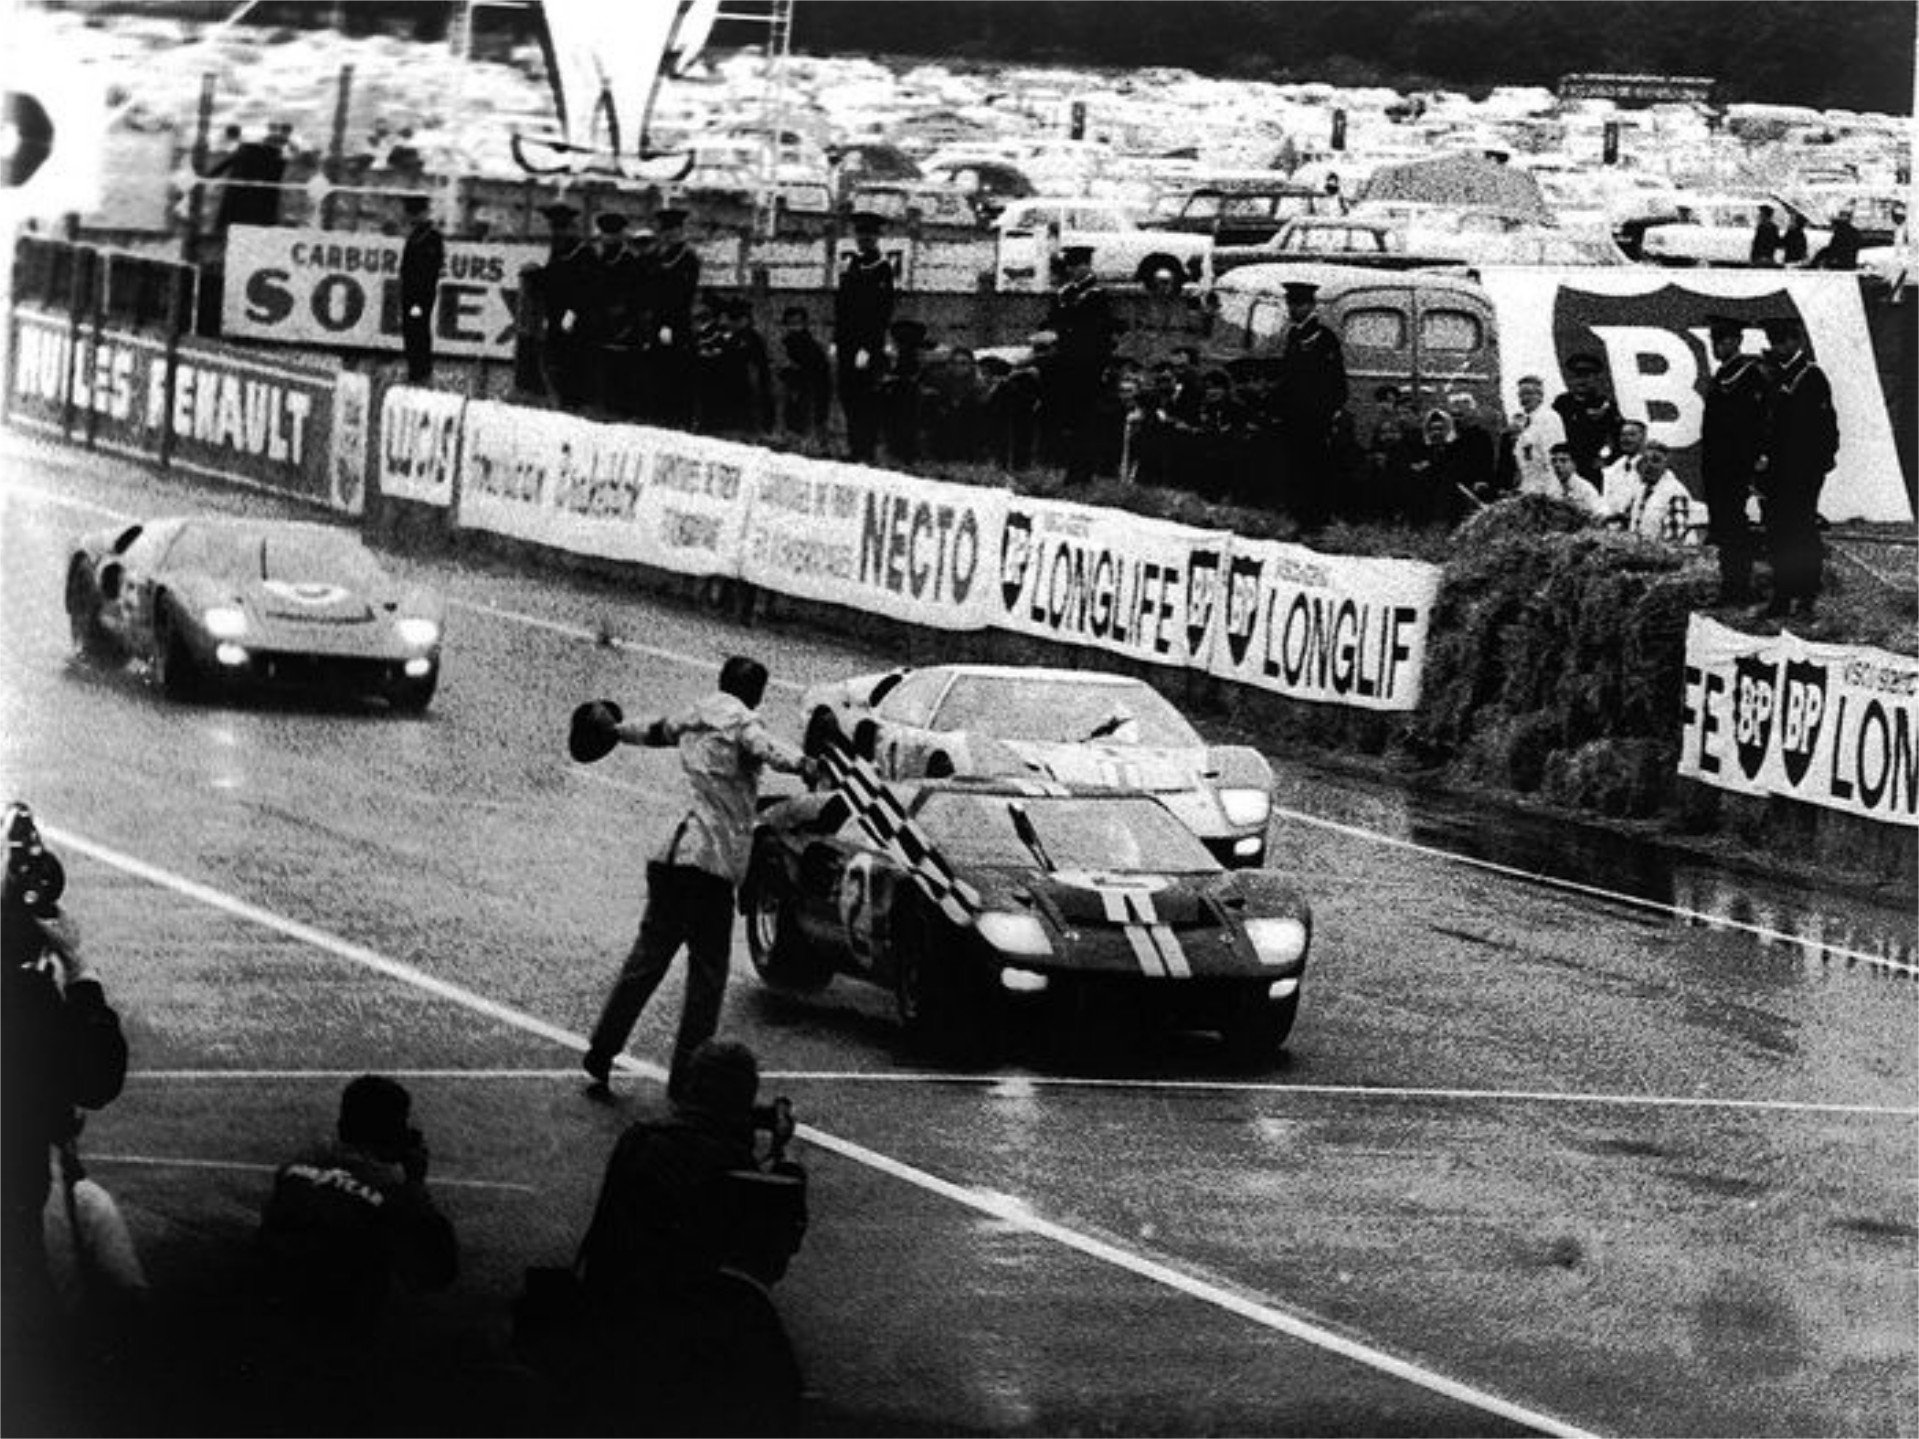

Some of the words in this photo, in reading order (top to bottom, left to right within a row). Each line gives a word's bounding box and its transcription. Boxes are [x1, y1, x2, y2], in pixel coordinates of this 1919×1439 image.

[291, 243, 504, 282] CARBURURS
[858, 490, 978, 604] NECTO
[1030, 540, 1180, 655] LONGLIFE
[1737, 675, 1772, 747] BP
[1783, 679, 1823, 753] BP
